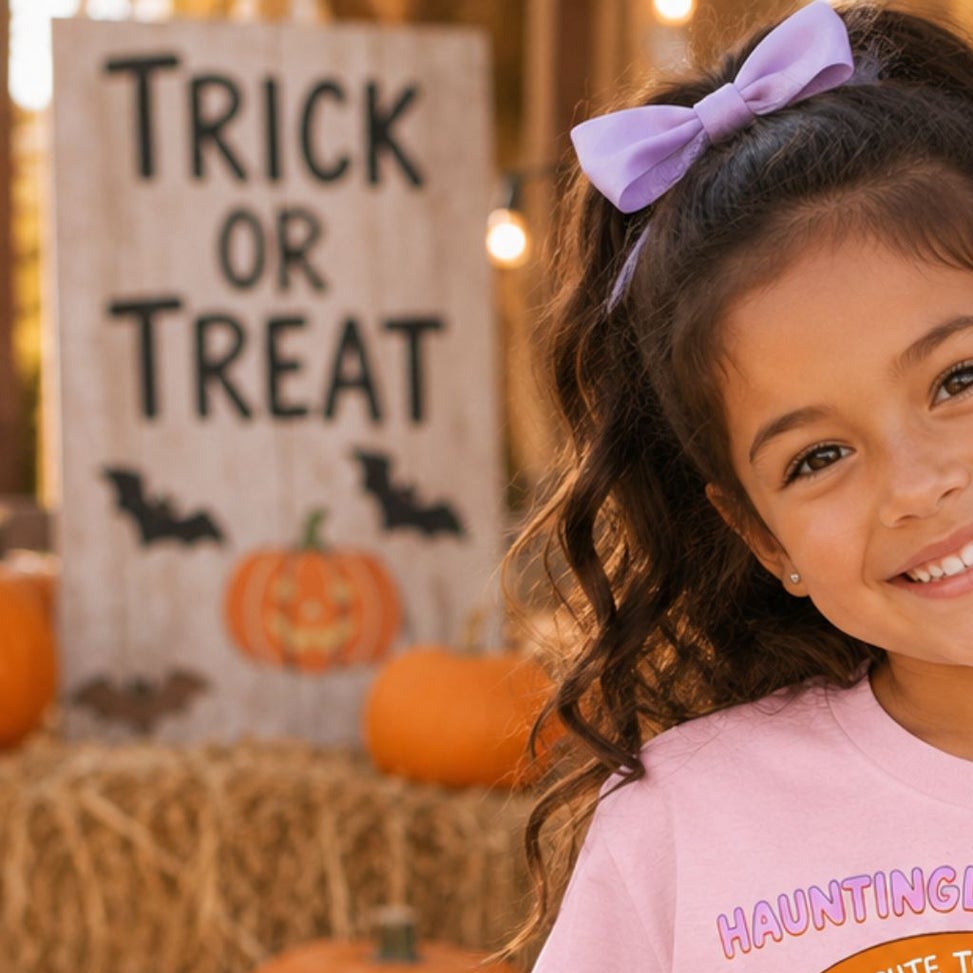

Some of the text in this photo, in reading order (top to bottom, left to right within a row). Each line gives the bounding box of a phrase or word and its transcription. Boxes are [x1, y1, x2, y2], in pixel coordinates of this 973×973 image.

[104, 54, 424, 189] TRICK
[217, 206, 327, 293] OR
[108, 297, 447, 424] TREAT
